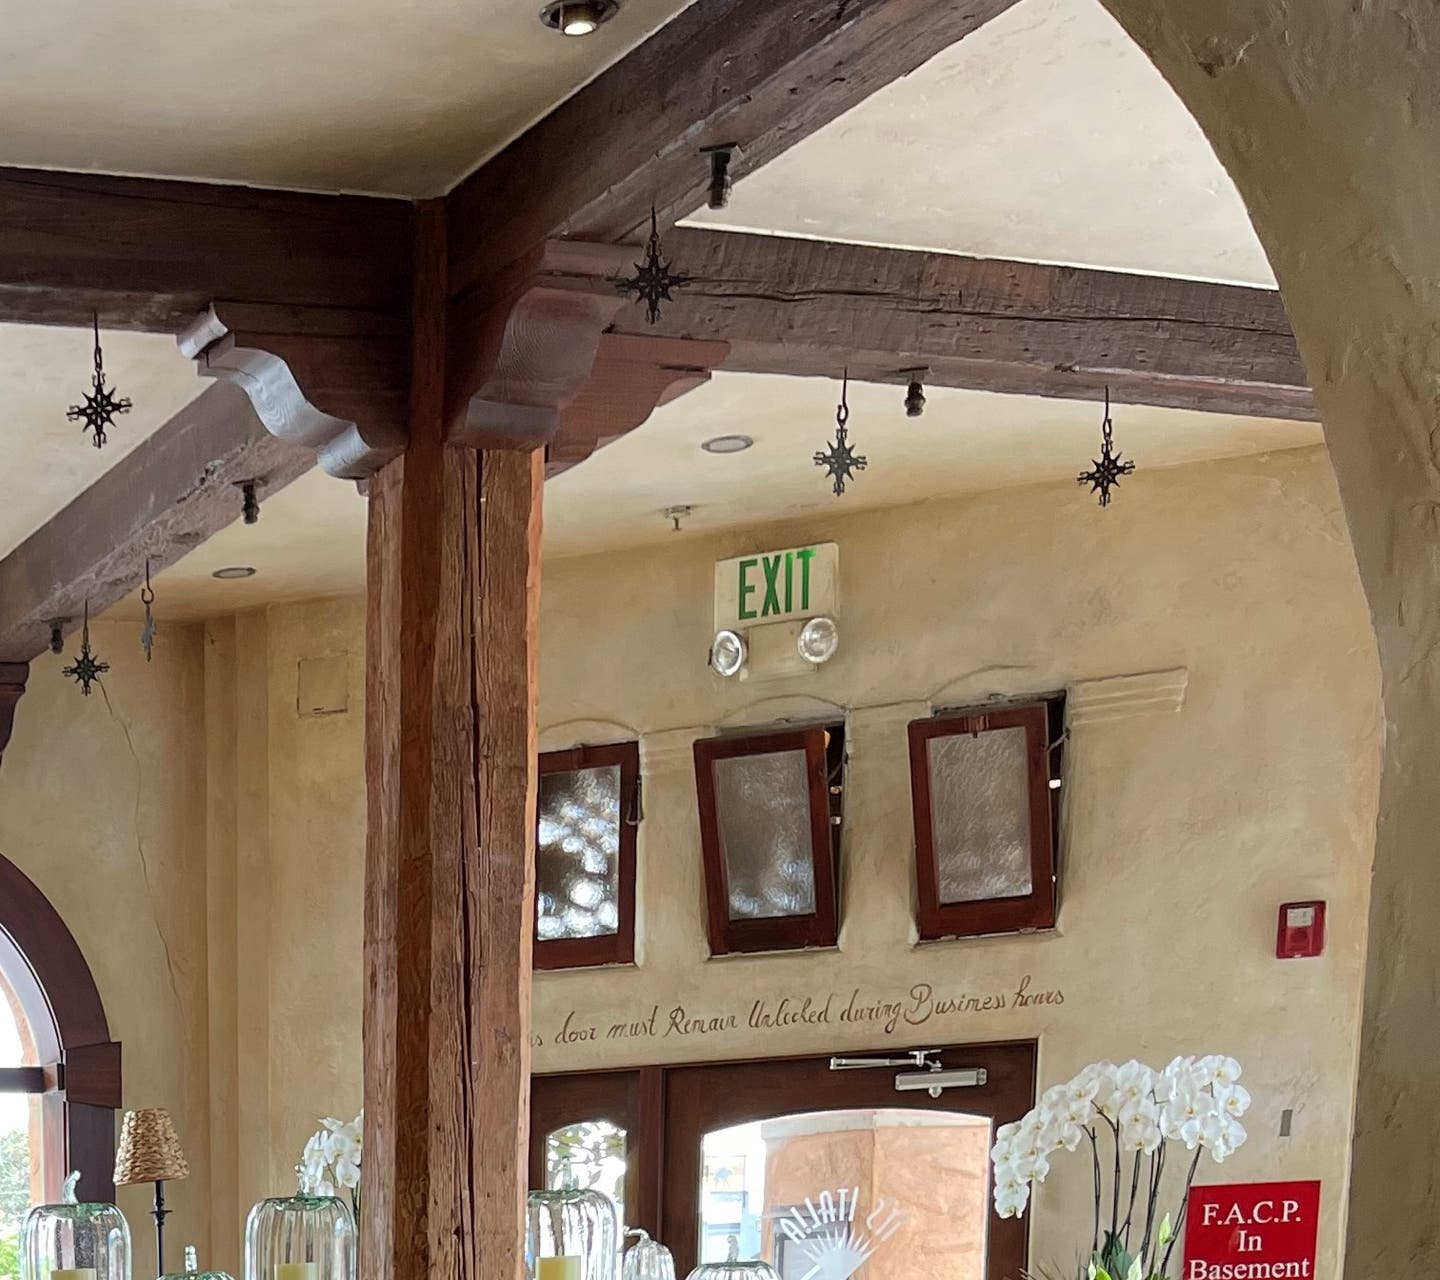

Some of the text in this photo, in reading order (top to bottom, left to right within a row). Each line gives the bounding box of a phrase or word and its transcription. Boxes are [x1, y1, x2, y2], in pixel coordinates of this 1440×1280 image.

[738, 547, 816, 620] EXIT
[555, 1011, 597, 1044] door
[606, 1005, 659, 1039] must
[663, 1005, 738, 1038] Remain
[748, 993, 833, 1029] Unlocked
[839, 988, 902, 1034] during
[903, 983, 1006, 1025] Business
[1011, 974, 1065, 1010] hours
[1201, 1200, 1301, 1226] F.A.C.P.
[1237, 1229, 1263, 1252] In
[1189, 1258, 1310, 1280] Basement
